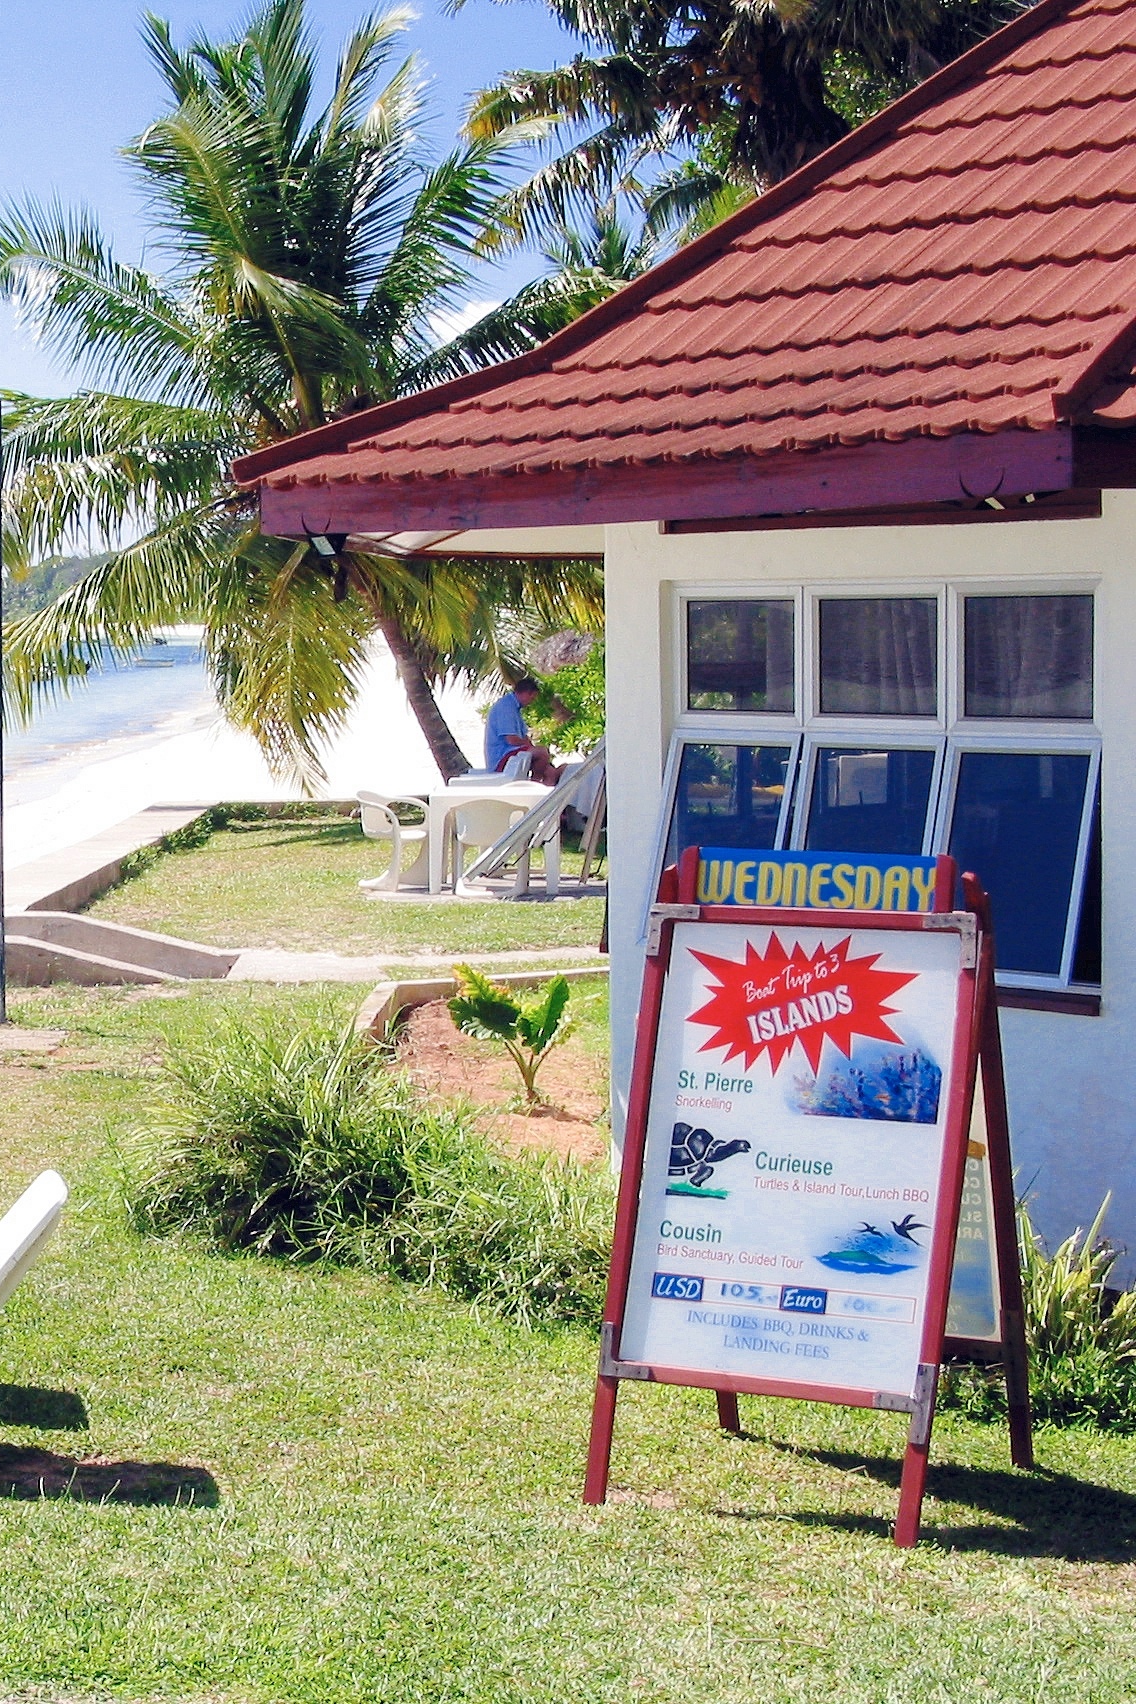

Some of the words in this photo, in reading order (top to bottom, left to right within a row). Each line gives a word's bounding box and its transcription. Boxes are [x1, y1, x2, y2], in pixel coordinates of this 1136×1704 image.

[697, 860, 937, 911] WEDNESDAY
[743, 976, 780, 1002] Boat
[782, 965, 813, 995] Trip
[813, 961, 828, 979] to
[829, 954, 840, 974] 3
[747, 985, 853, 1045] ISLANDS
[678, 1070, 699, 1090] St.
[704, 1072, 754, 1094] Pierre
[675, 1095, 733, 1112] Snorkelling
[755, 1151, 833, 1176] Curieuse
[754, 1177, 790, 1191] Turtles
[793, 1179, 802, 1192] &
[803, 1180, 836, 1195] Island
[902, 1187, 930, 1204] BBQ
[660, 1219, 722, 1244] Cousin
[657, 1243, 678, 1257] Bird
[681, 1245, 735, 1265] Sanctuary,
[738, 1250, 777, 1267] Guided
[780, 1254, 804, 1269] Tour
[657, 1276, 701, 1299] USD
[784, 1290, 823, 1311] Euro
[687, 1310, 758, 1331] INCLUDES
[799, 1322, 854, 1342] DRINKS
[858, 1329, 870, 1342] &
[723, 1335, 792, 1356] LANDING
[795, 1343, 830, 1360] FEES
